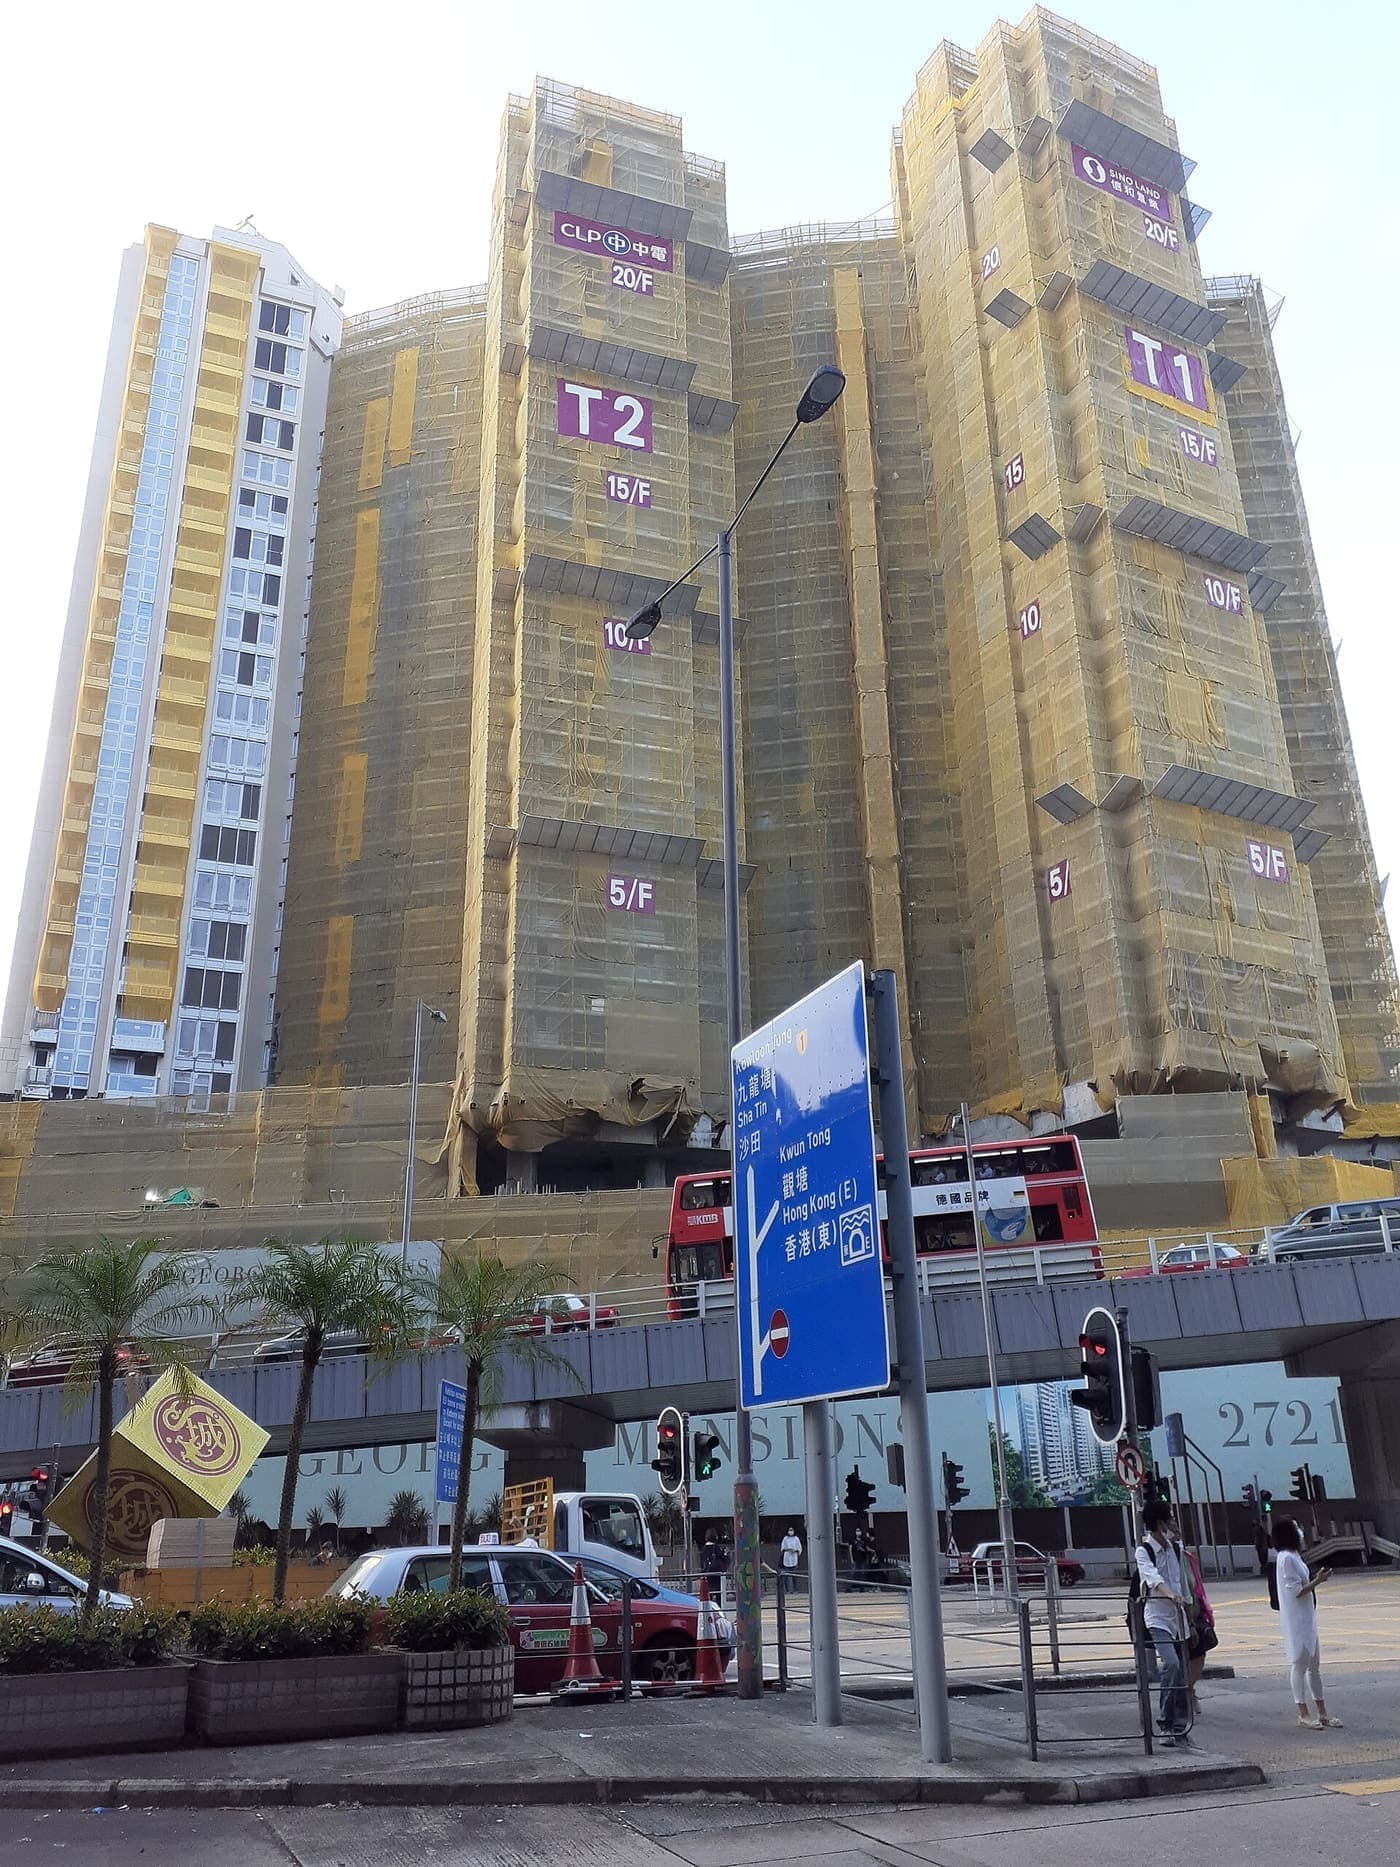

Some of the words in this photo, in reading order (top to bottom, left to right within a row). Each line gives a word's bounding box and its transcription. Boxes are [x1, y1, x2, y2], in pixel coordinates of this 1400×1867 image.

[1108, 168, 1134, 187] SINO
[1134, 180, 1161, 200] LAND
[560, 223, 602, 243] CLP
[1144, 217, 1179, 249] 20/F
[632, 241, 668, 263] 中電
[612, 265, 653, 292] 20/F
[1131, 330, 1194, 403] T1
[564, 382, 646, 448] T2
[1180, 431, 1217, 463] 15/F
[607, 475, 651, 505] 15/F
[1204, 577, 1242, 611] 10/F
[1248, 844, 1287, 878] 5/F
[609, 878, 653, 910] 5/F
[734, 1041, 772, 1076] Kowloon
[736, 1066, 773, 1107] 九龍塘
[737, 1108, 754, 1129] Sha
[754, 1100, 768, 1119] Tin
[738, 1129, 761, 1161] 沙田
[779, 1140, 806, 1165] Kwun
[806, 1127, 831, 1150] Tong
[782, 1165, 809, 1201] 觀塘
[935, 1190, 990, 1207] 德國品牌
[783, 1200, 809, 1226] Hong
[809, 1191, 837, 1214] Kong
[838, 1177, 858, 1207] (E)
[784, 1219, 838, 1263] 香港(東)
[865, 1236, 871, 1249] E
[1218, 1398, 1348, 1448] 2721
